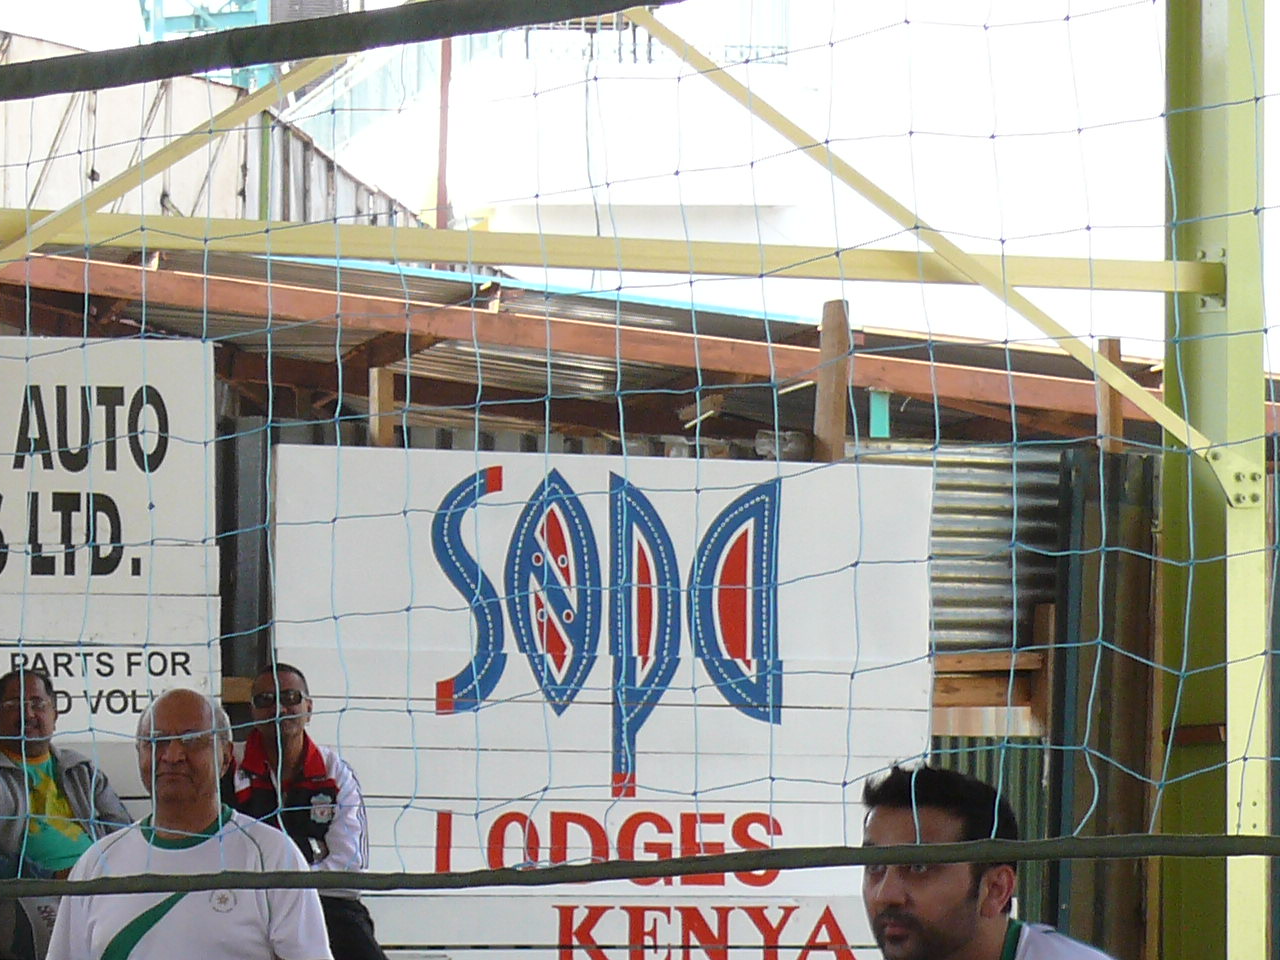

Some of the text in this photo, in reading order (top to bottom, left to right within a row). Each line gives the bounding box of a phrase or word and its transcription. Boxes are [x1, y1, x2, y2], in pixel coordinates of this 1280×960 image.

[13, 383, 170, 473] AUTO
[29, 491, 143, 579] LTD.
[11, 652, 114, 678] PARTS
[127, 652, 192, 677] FOR
